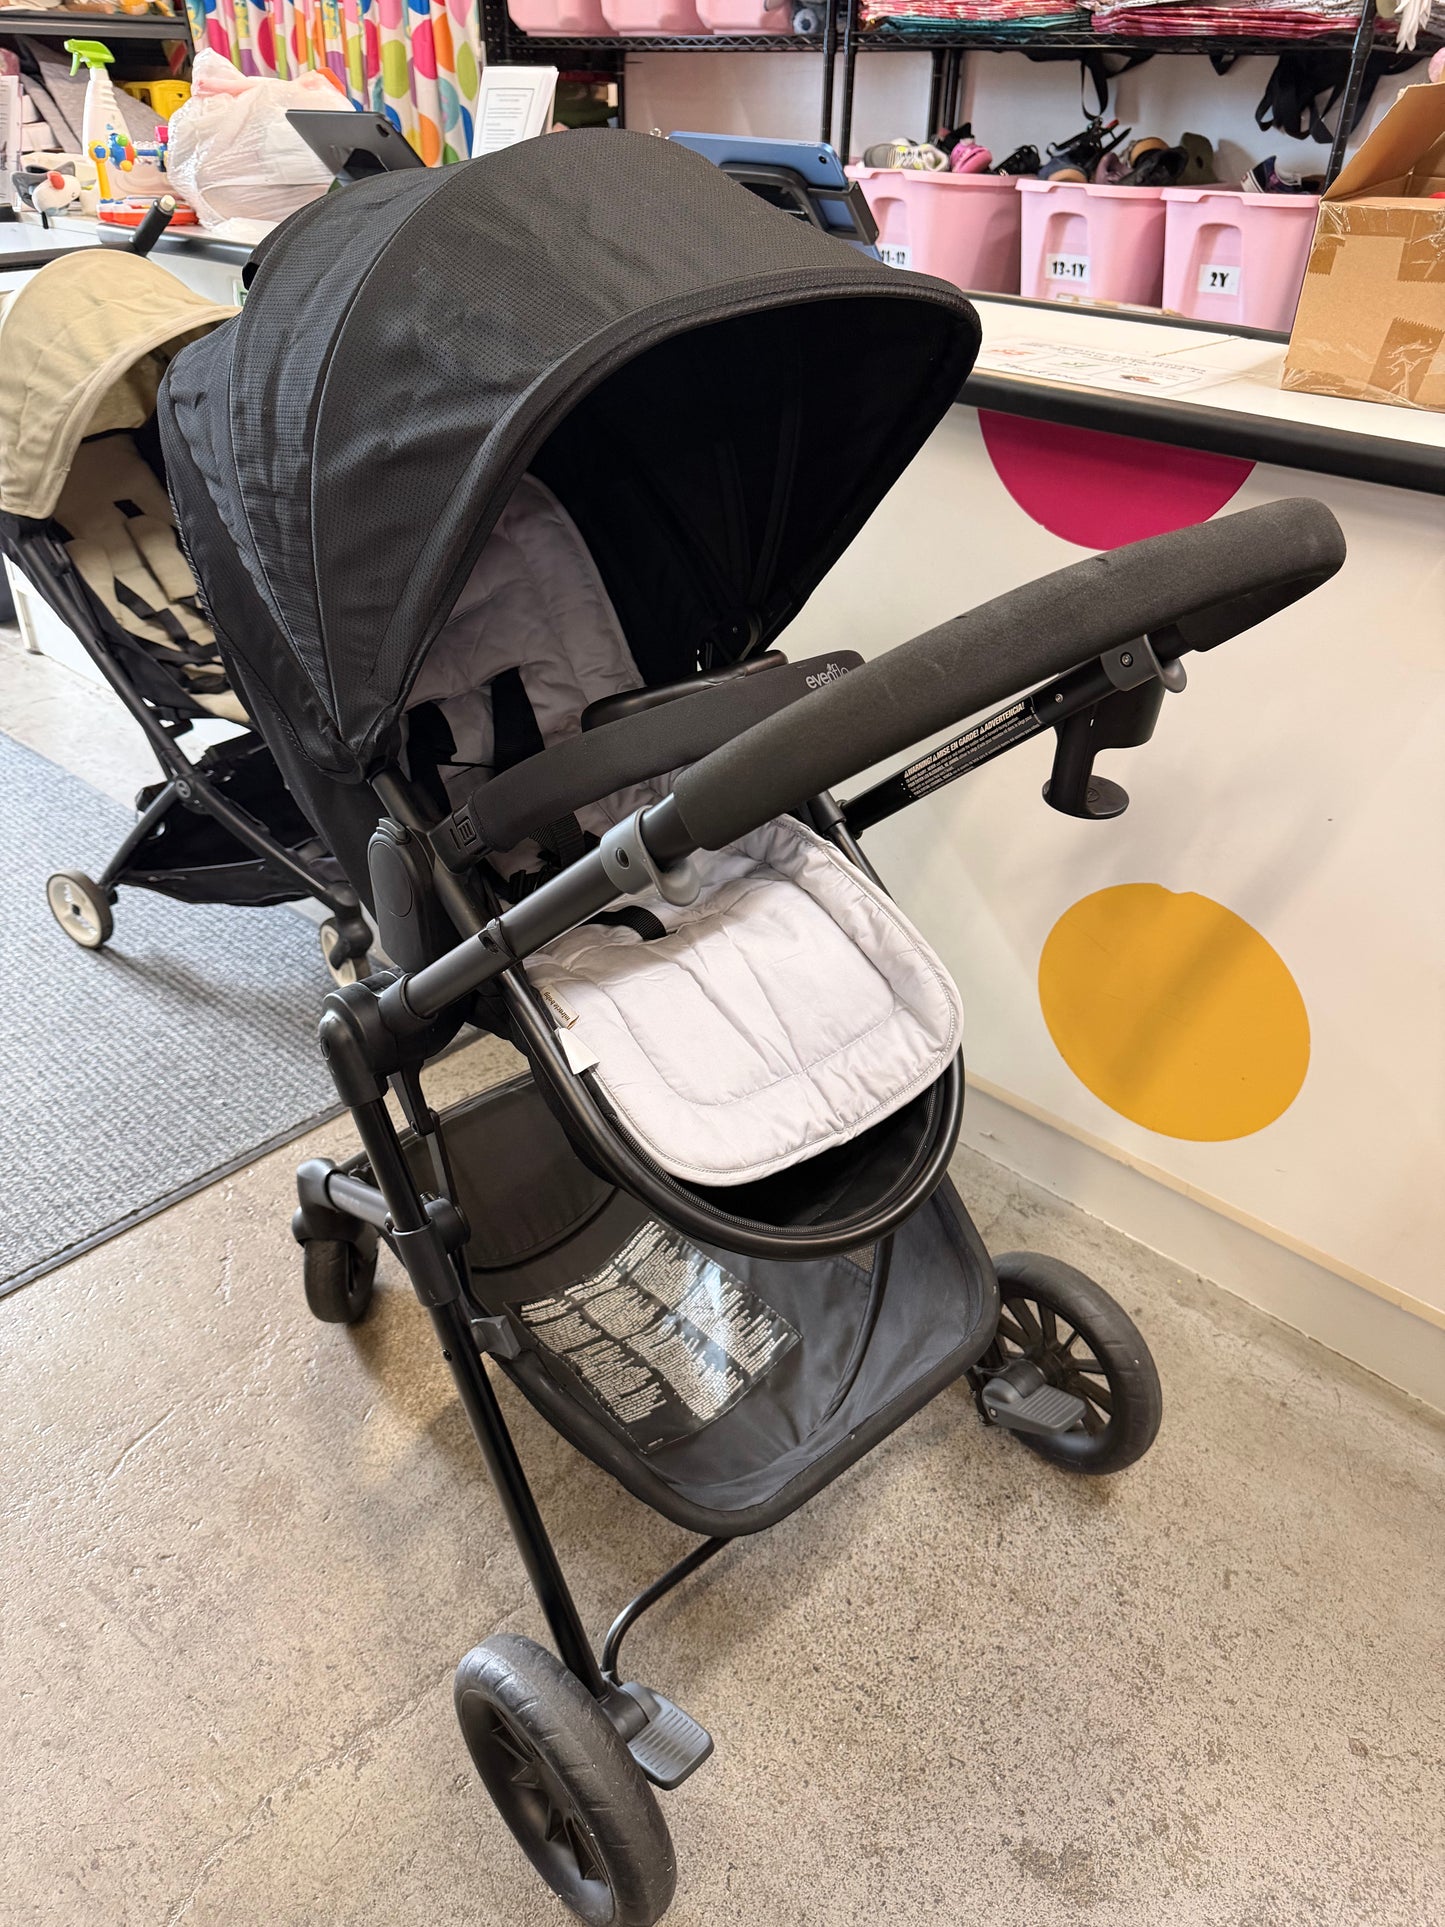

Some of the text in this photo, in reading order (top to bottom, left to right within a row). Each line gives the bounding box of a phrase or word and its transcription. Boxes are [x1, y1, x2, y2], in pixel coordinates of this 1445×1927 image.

[1053, 261, 1087, 278] 13-1Y
[1210, 271, 1230, 287] 2Y
[936, 746, 951, 760] MISE
[950, 741, 959, 751] EN
[958, 728, 980, 747] GARDE!
[984, 702, 1025, 731] ADVERTENCIA!
[593, 1264, 615, 1284] GARDE
[617, 1220, 655, 1259] ADVERTENCIA
